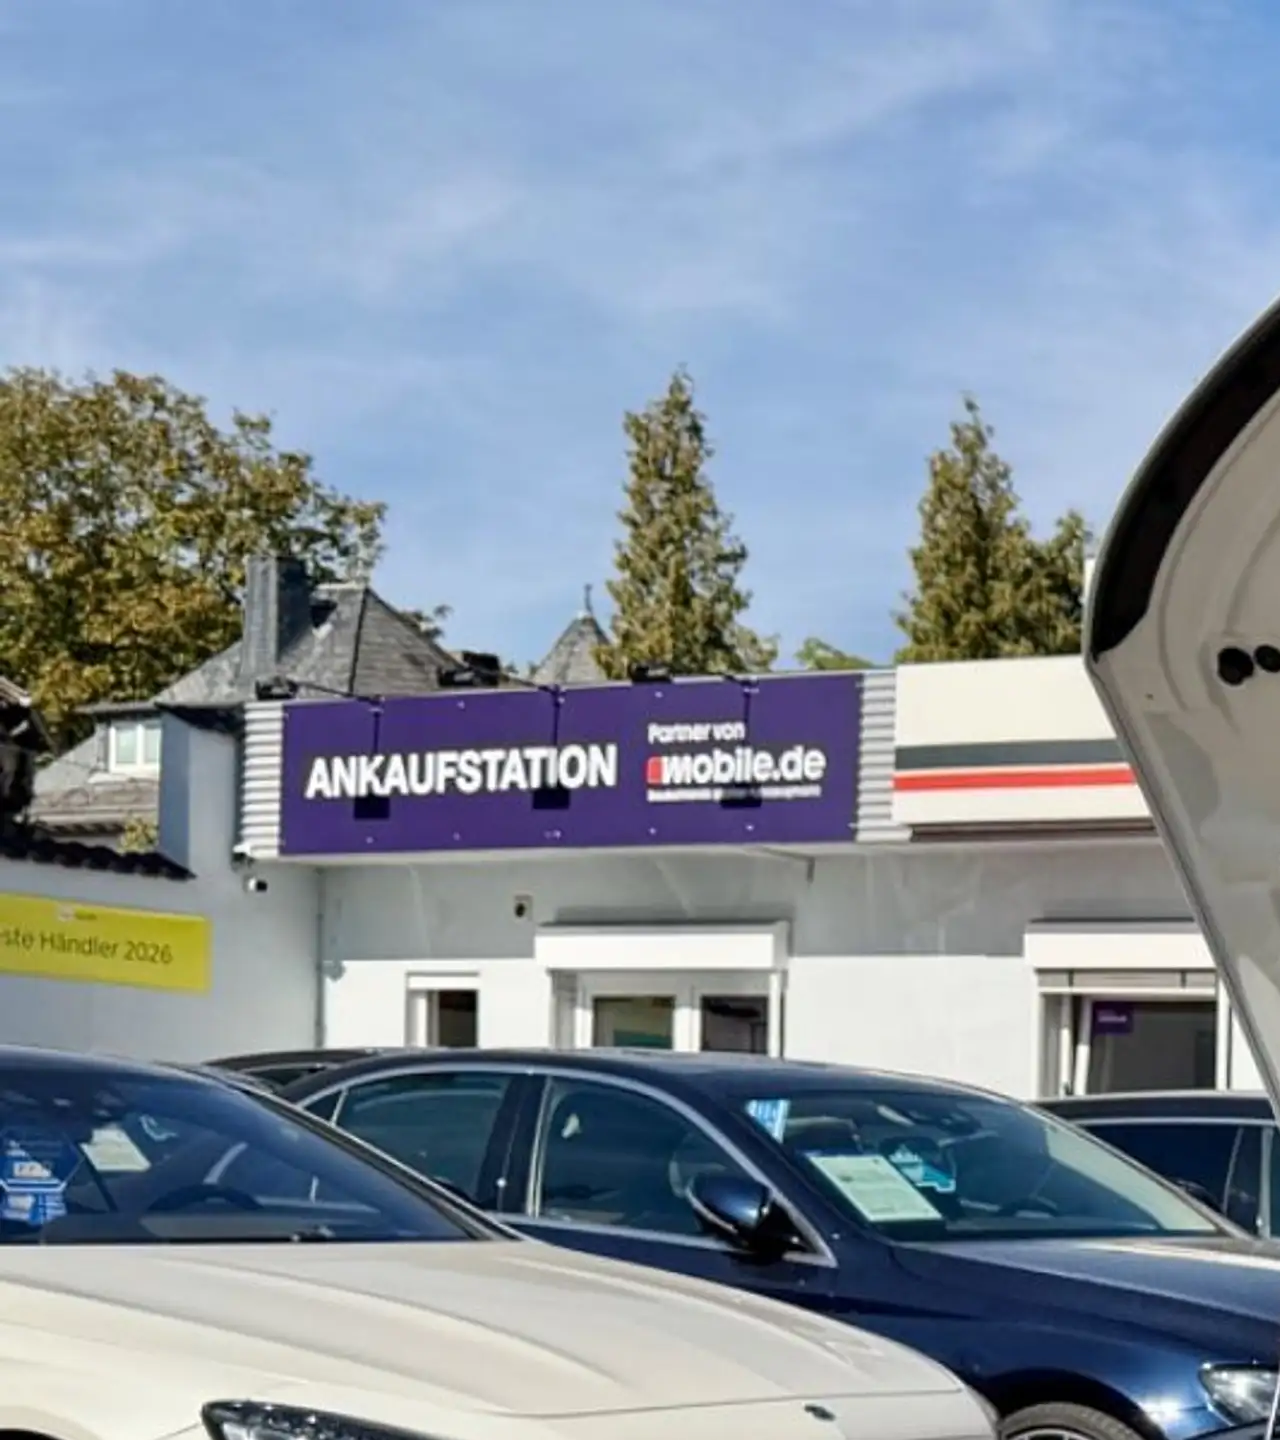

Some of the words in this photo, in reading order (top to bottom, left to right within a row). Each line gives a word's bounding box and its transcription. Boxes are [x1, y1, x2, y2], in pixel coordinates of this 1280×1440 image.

[648, 723, 711, 744] Partner
[712, 722, 746, 741] von
[305, 744, 618, 799] ANKAUFSTATION
[39, 931, 119, 958] Händler
[124, 940, 174, 965] 2026
